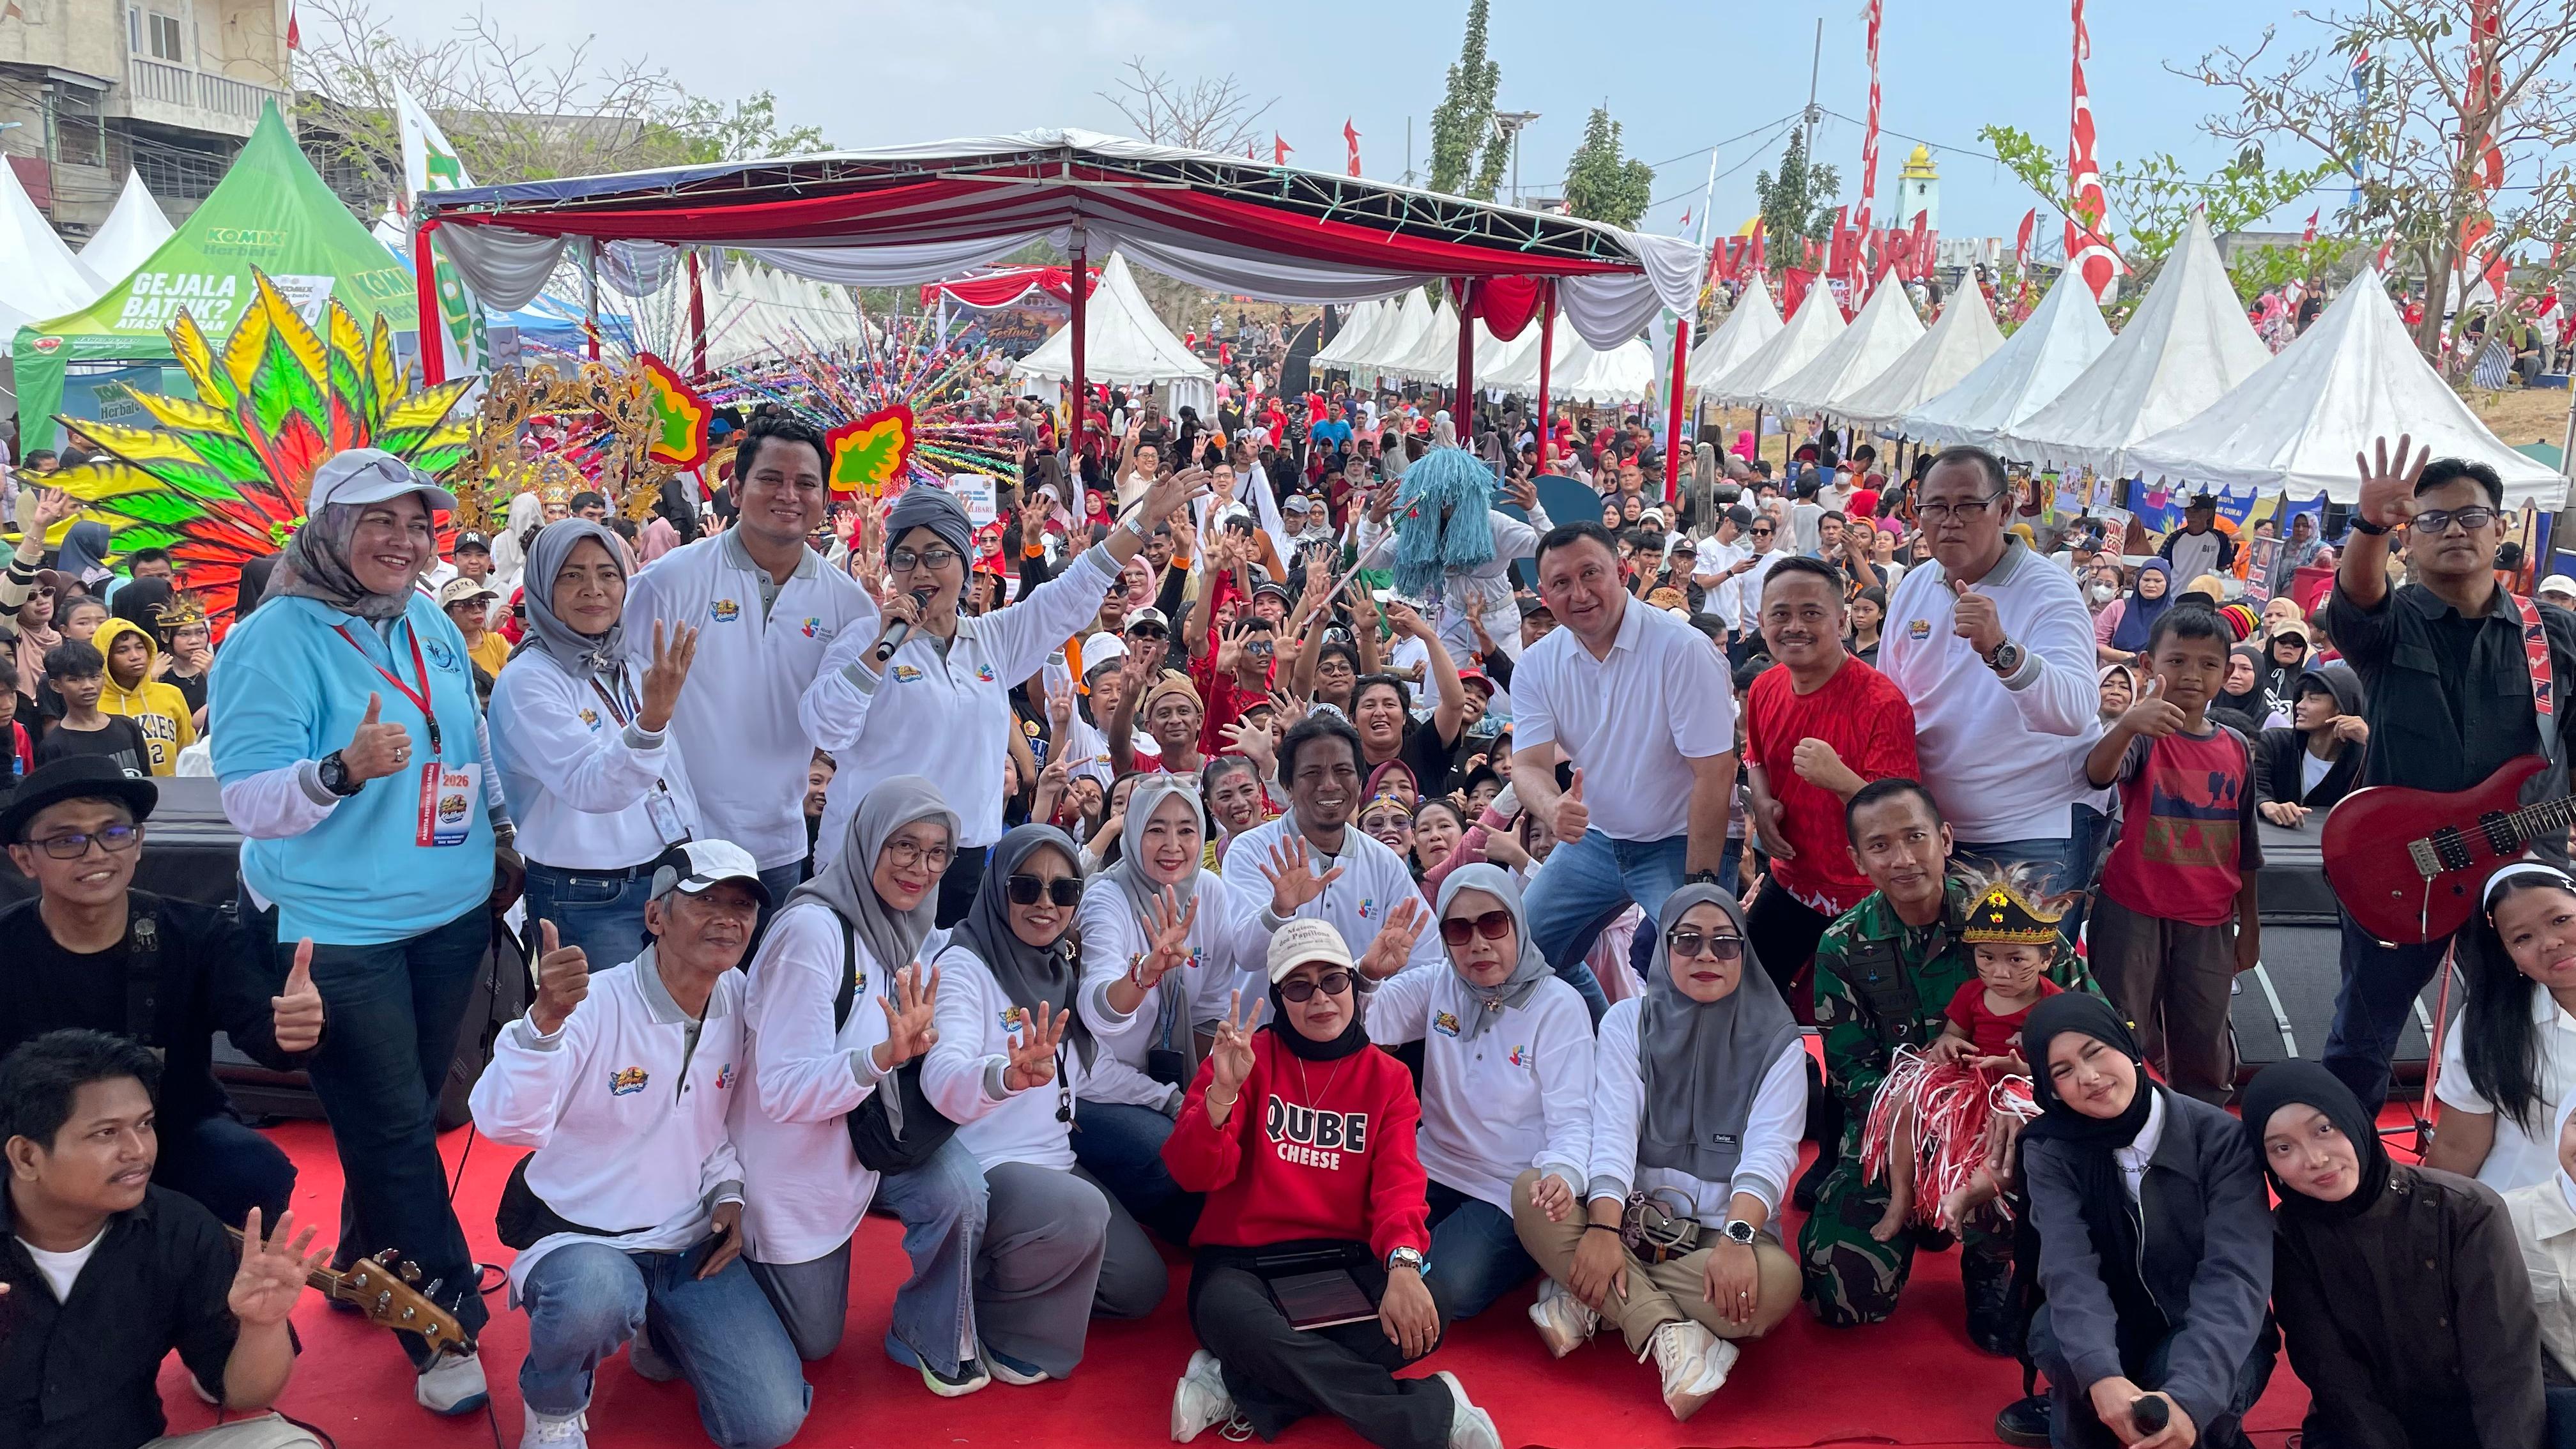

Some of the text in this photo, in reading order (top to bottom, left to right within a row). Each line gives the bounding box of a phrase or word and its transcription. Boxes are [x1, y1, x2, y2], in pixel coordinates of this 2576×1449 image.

[206, 229, 285, 245] KOMIX
[203, 245, 270, 256] Herbal
[132, 273, 236, 297] GEJALA
[352, 268, 417, 298] KOMI
[384, 302, 418, 321] Herb
[114, 319, 165, 330] ATASI
[987, 326, 1035, 339] Festival
[91, 379, 135, 402] KOM
[101, 402, 135, 419] Herbal
[2224, 507, 2242, 517] CUKAI
[466, 532, 479, 542] NY
[133, 714, 176, 742] KIES
[443, 774, 470, 787] 2026
[1288, 924, 1318, 933] Maison
[1279, 938, 1290, 947] des
[1292, 930, 1330, 940] Papillons
[1266, 1093, 1368, 1154] QUBE
[1278, 1142, 1340, 1171] CHEESE
